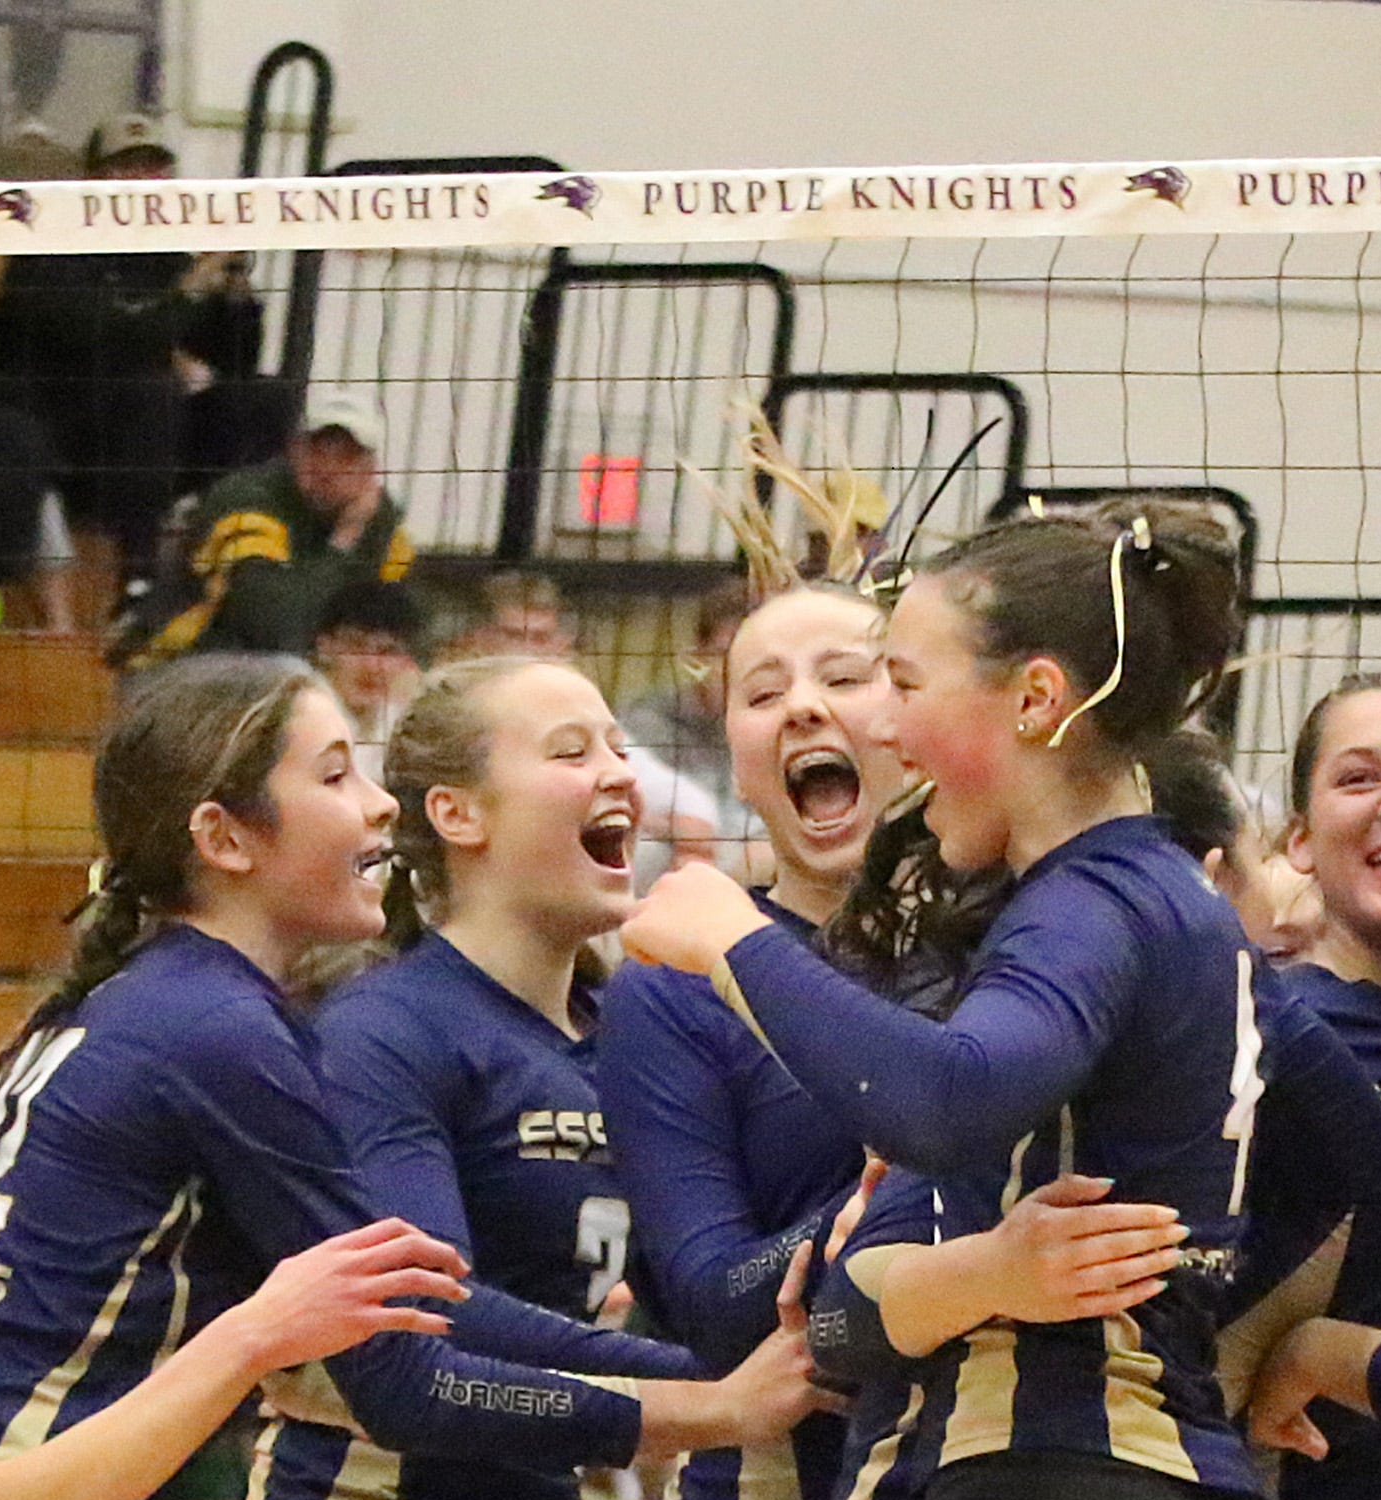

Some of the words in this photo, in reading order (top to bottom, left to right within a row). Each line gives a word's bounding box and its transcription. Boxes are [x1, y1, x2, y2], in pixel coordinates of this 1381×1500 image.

[82, 191, 256, 227] PURPLE
[277, 183, 491, 223] KNIGHTS
[642, 177, 824, 216] PURPLE
[850, 174, 1078, 212] KNIGHTS
[427, 1368, 574, 1417] HORNETS
